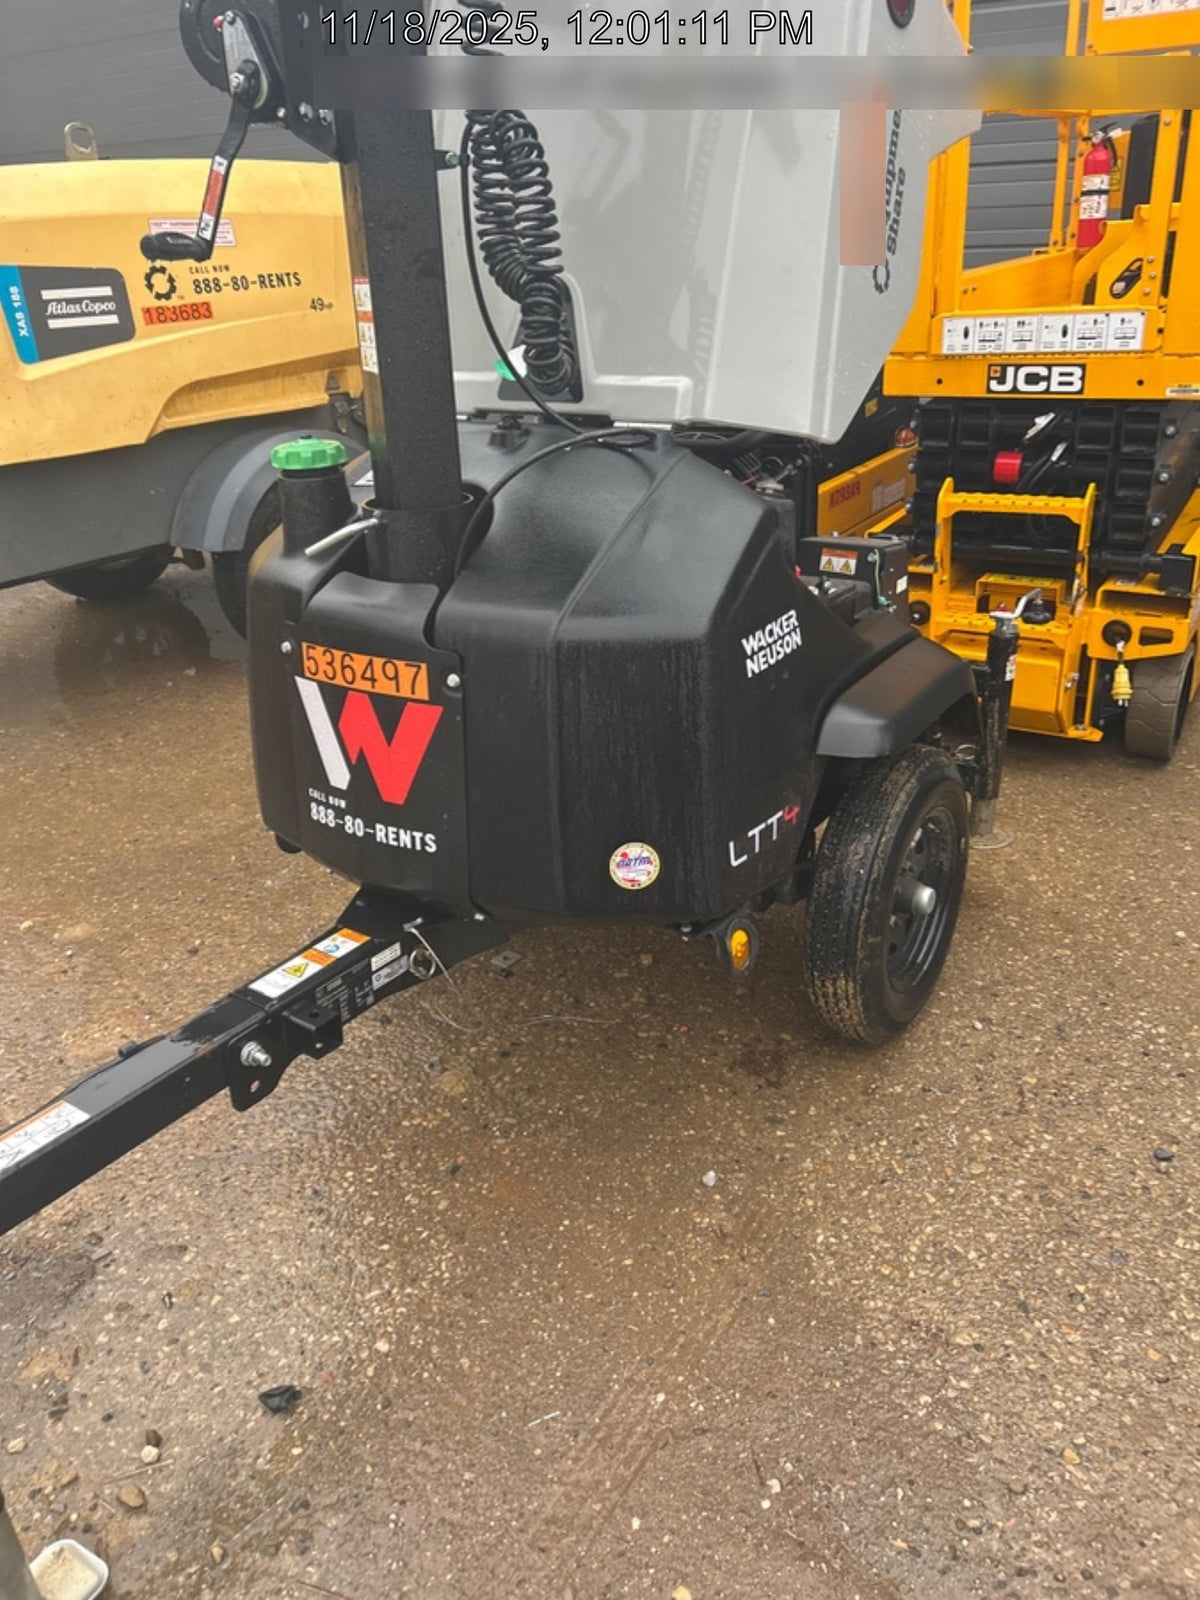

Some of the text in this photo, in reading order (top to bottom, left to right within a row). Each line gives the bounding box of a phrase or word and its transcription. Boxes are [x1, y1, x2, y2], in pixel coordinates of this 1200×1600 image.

[886, 166, 906, 256] Share
[189, 266, 210, 275] CALL
[192, 271, 302, 295] 888-80-RENTS
[14, 311, 29, 337] XAS
[143, 302, 213, 325] 183683
[989, 365, 1083, 393] JCB
[741, 609, 799, 656] WACKER
[745, 628, 803, 678] NEUSON
[305, 643, 423, 696] 536497
[309, 801, 438, 853] 888-80-RENTS
[729, 804, 801, 867] LTT4
